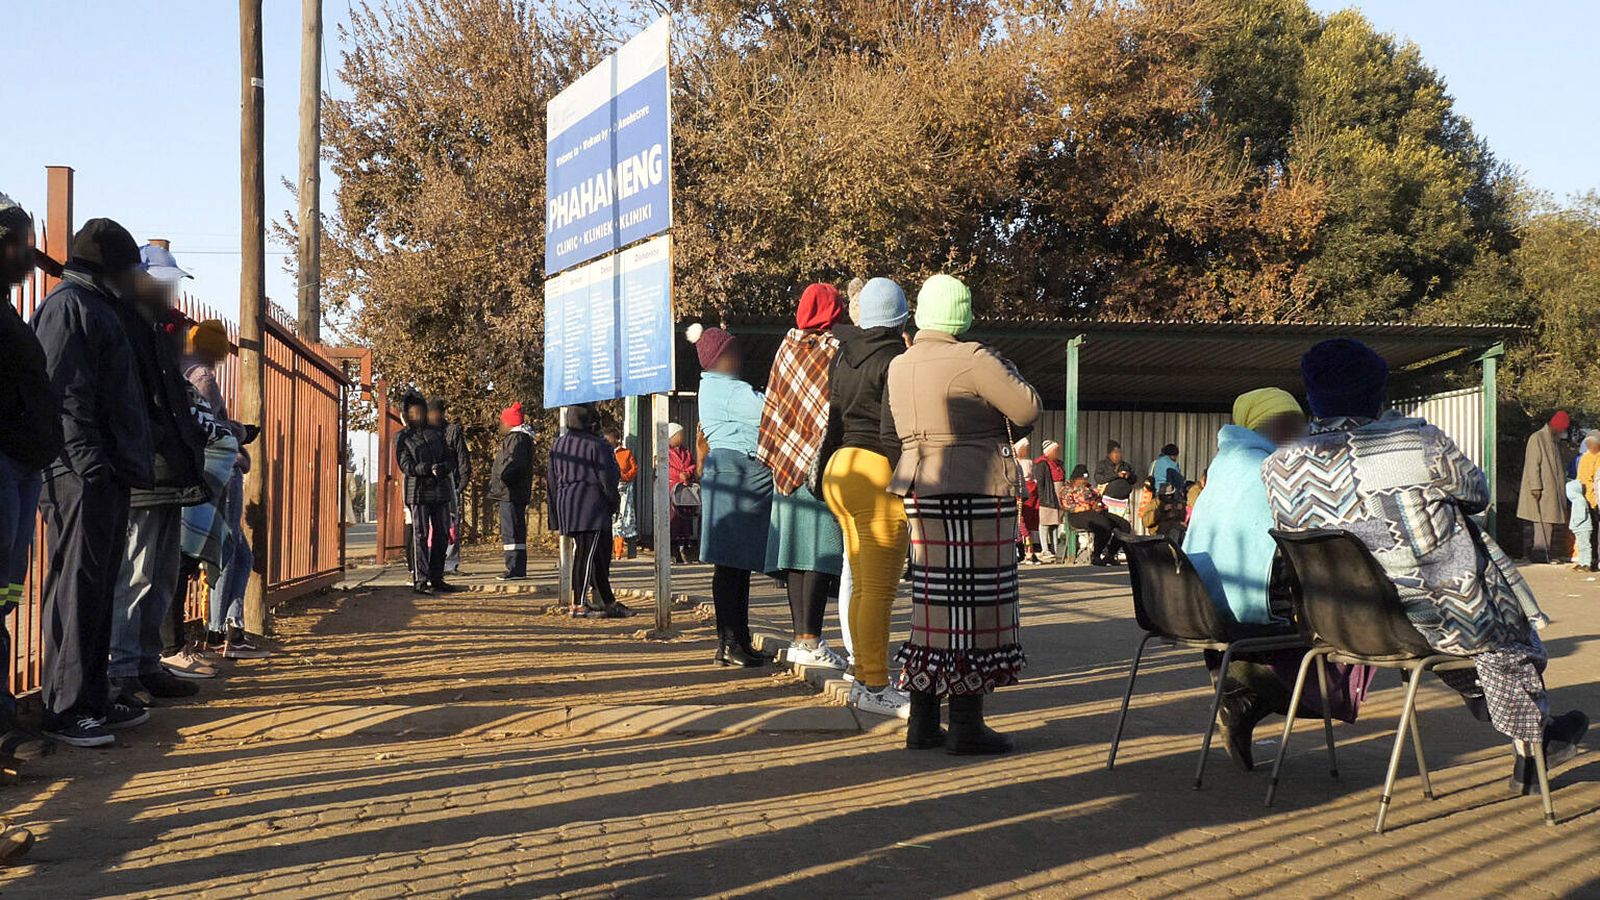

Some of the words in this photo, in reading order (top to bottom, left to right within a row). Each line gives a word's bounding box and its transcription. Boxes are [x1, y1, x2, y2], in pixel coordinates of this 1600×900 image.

[549, 144, 662, 233] PHAHAMENG
[556, 236, 578, 256] CLINIC
[584, 220, 613, 244] KLINIEK
[619, 204, 651, 230] KLINIKI
